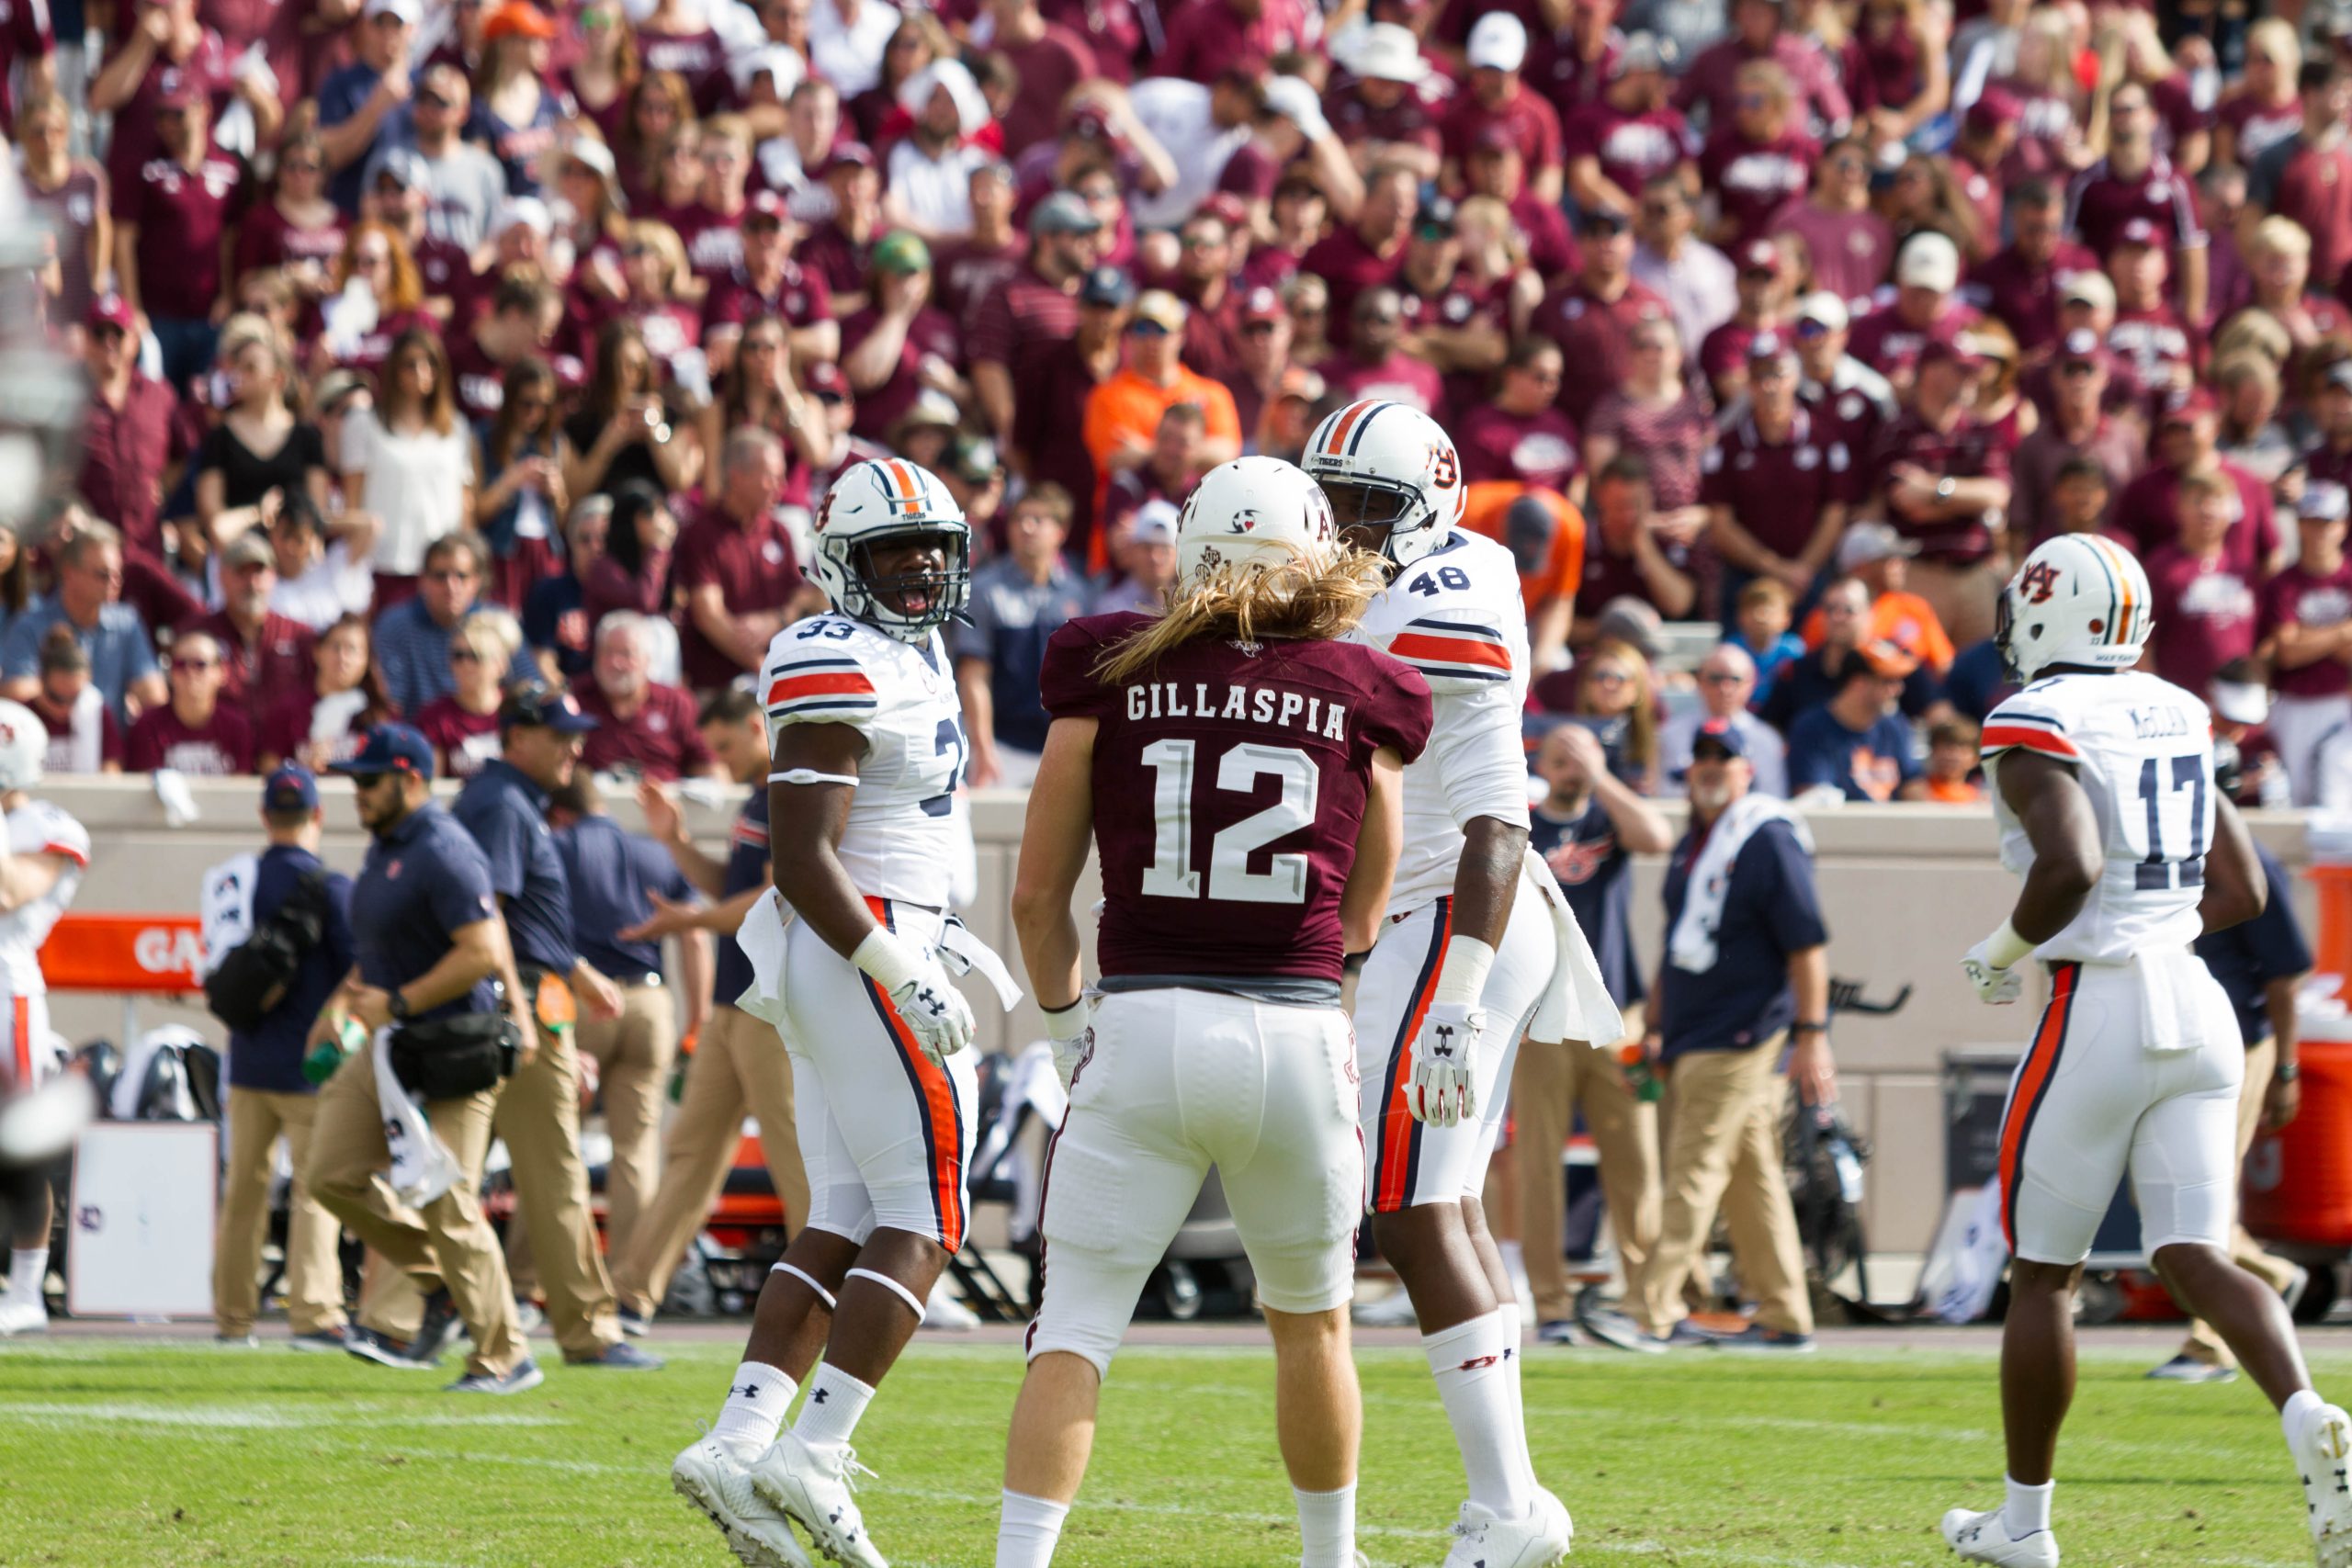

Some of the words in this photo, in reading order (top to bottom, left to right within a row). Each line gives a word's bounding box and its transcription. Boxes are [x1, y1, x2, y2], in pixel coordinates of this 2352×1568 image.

[1318, 456, 1343, 468] TIGERS
[901, 512, 926, 522] TIGERS
[1408, 566, 1472, 598] 48
[797, 620, 857, 640] 33
[1126, 682, 1346, 742] GILLASPIA
[1140, 738, 1320, 905] 12
[2134, 753, 2206, 891] 17
